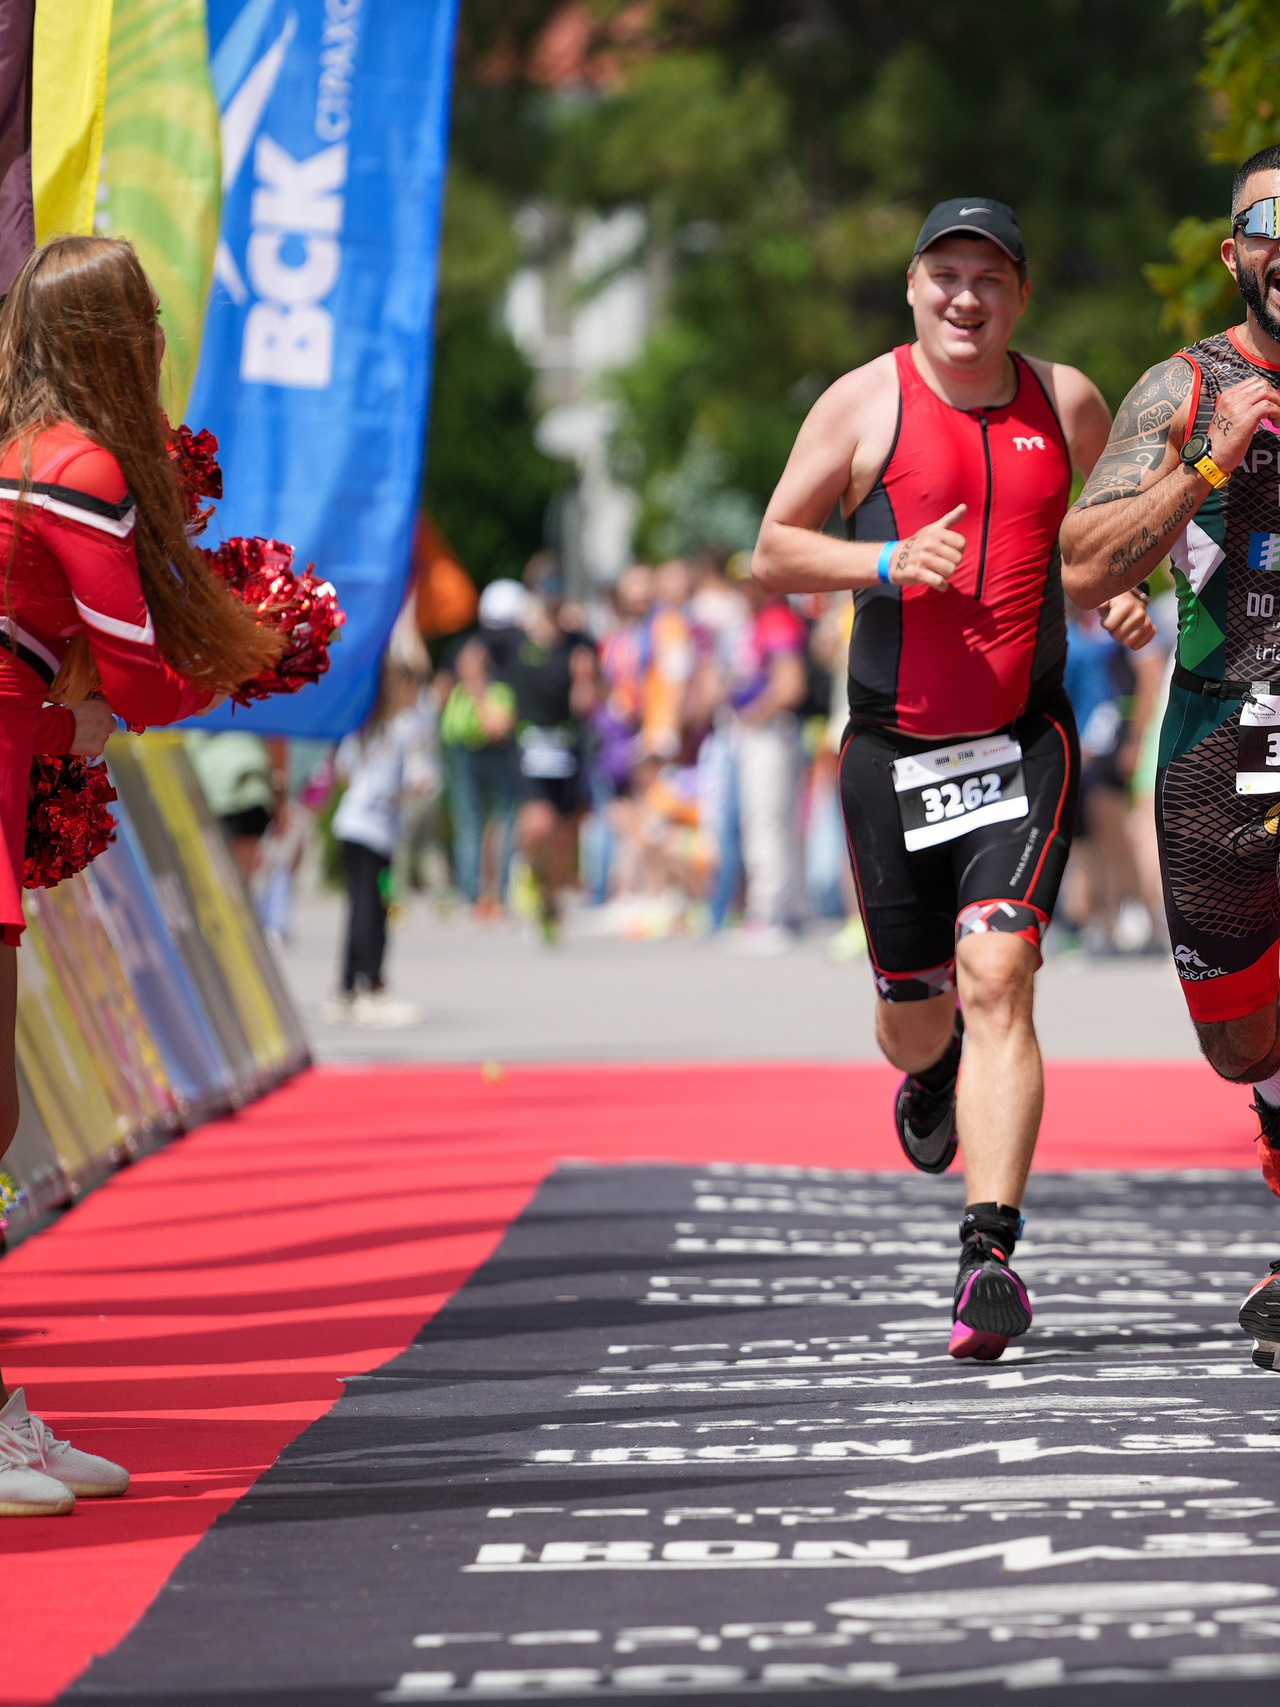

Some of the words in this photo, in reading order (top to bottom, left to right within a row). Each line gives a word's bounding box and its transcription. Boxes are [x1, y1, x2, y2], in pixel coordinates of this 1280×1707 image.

[1012, 435, 1046, 451] TYR
[1246, 592, 1275, 617] DO
[921, 772, 1002, 823] 3262
[532, 1438, 913, 1462] IRON
[475, 1538, 910, 1564] IRON
[396, 1660, 899, 1696] IRON
